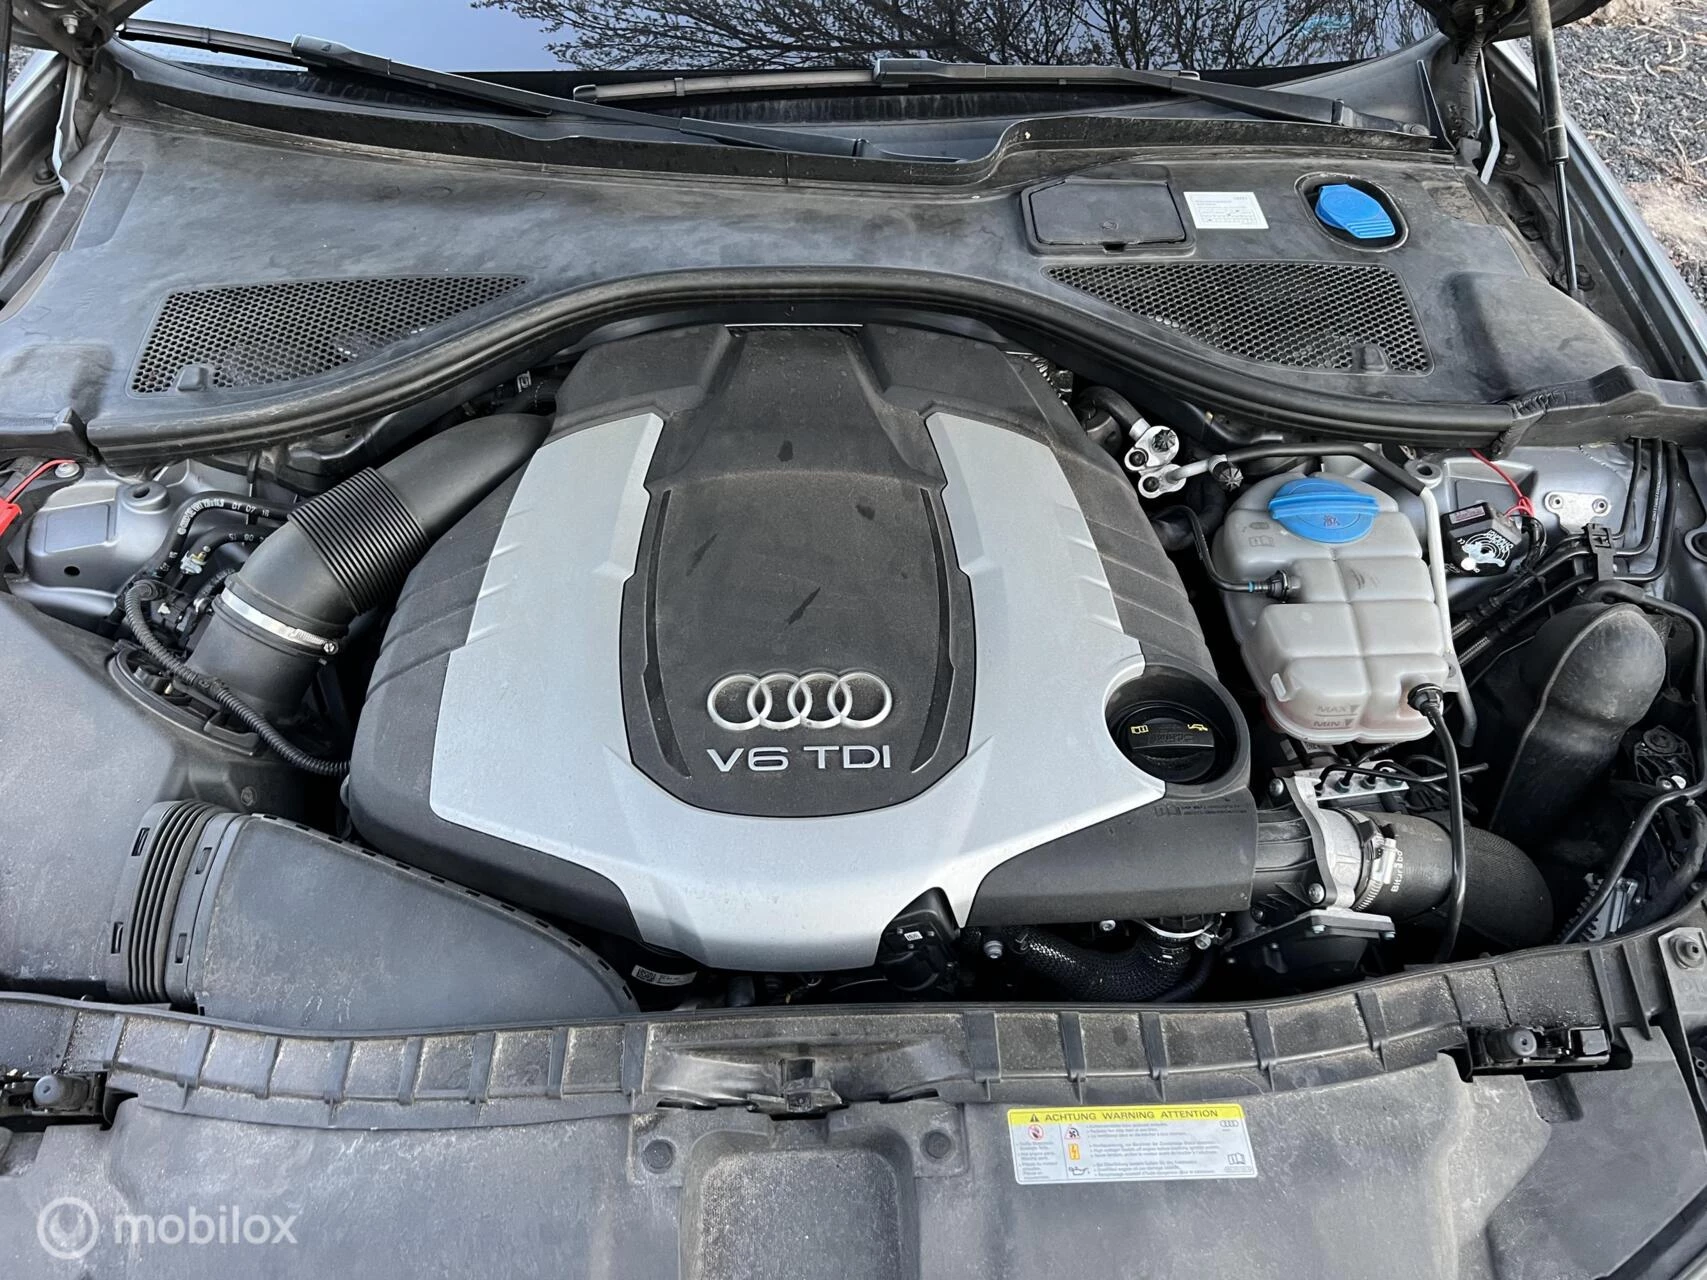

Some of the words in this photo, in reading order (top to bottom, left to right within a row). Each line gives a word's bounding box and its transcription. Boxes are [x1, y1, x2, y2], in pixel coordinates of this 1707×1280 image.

[706, 746, 789, 773] V6
[803, 745, 891, 769] TDI
[1044, 1112, 1097, 1122] ACHTUNG
[1102, 1110, 1155, 1120] WARNING
[1160, 1109, 1218, 1119] ATTENTION
